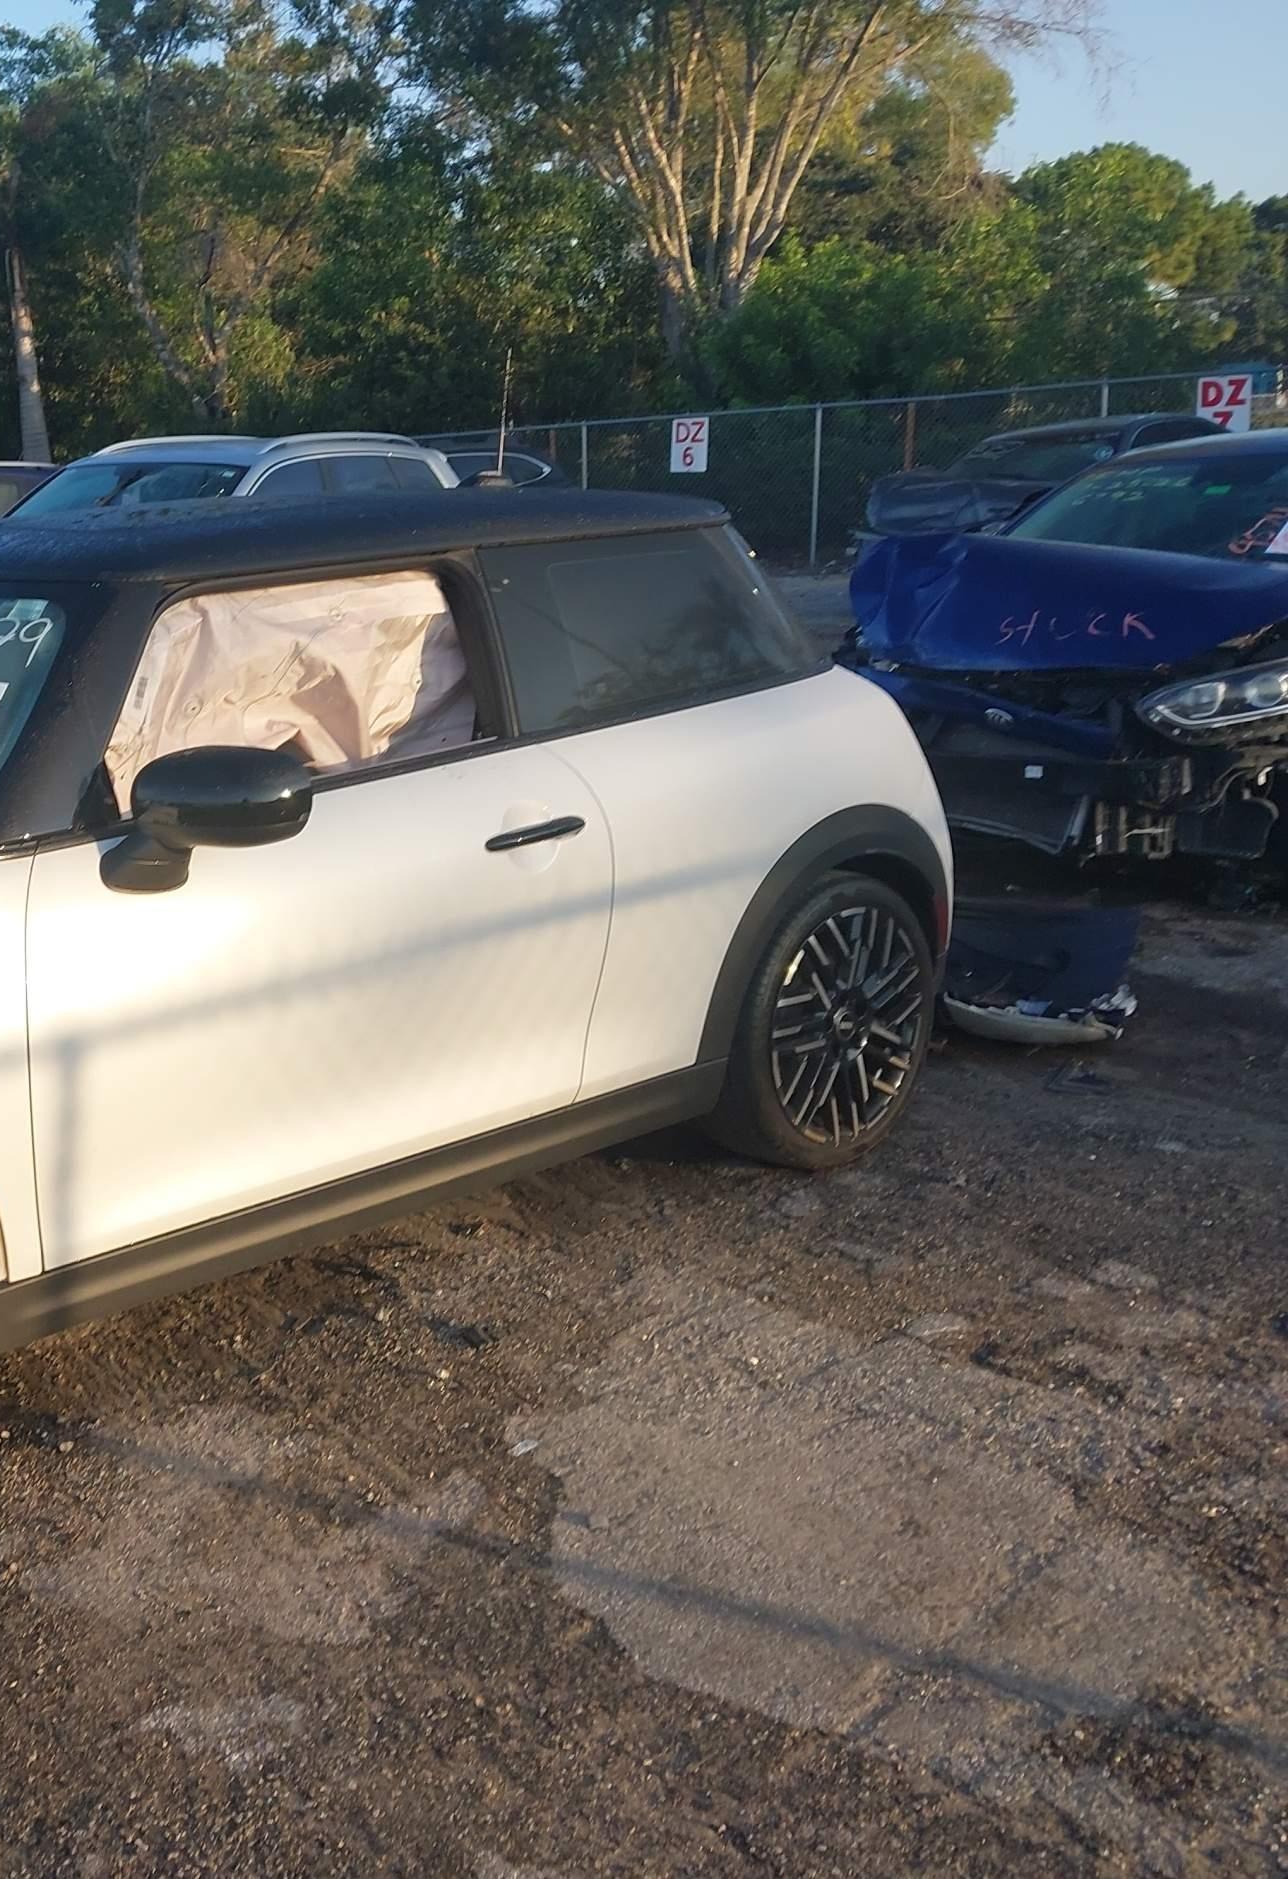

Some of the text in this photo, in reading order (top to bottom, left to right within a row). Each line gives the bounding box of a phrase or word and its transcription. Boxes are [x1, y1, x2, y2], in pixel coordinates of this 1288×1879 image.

[1201, 379, 1249, 408] DZ
[675, 422, 705, 443] DZ
[683, 447, 694, 467] 6
